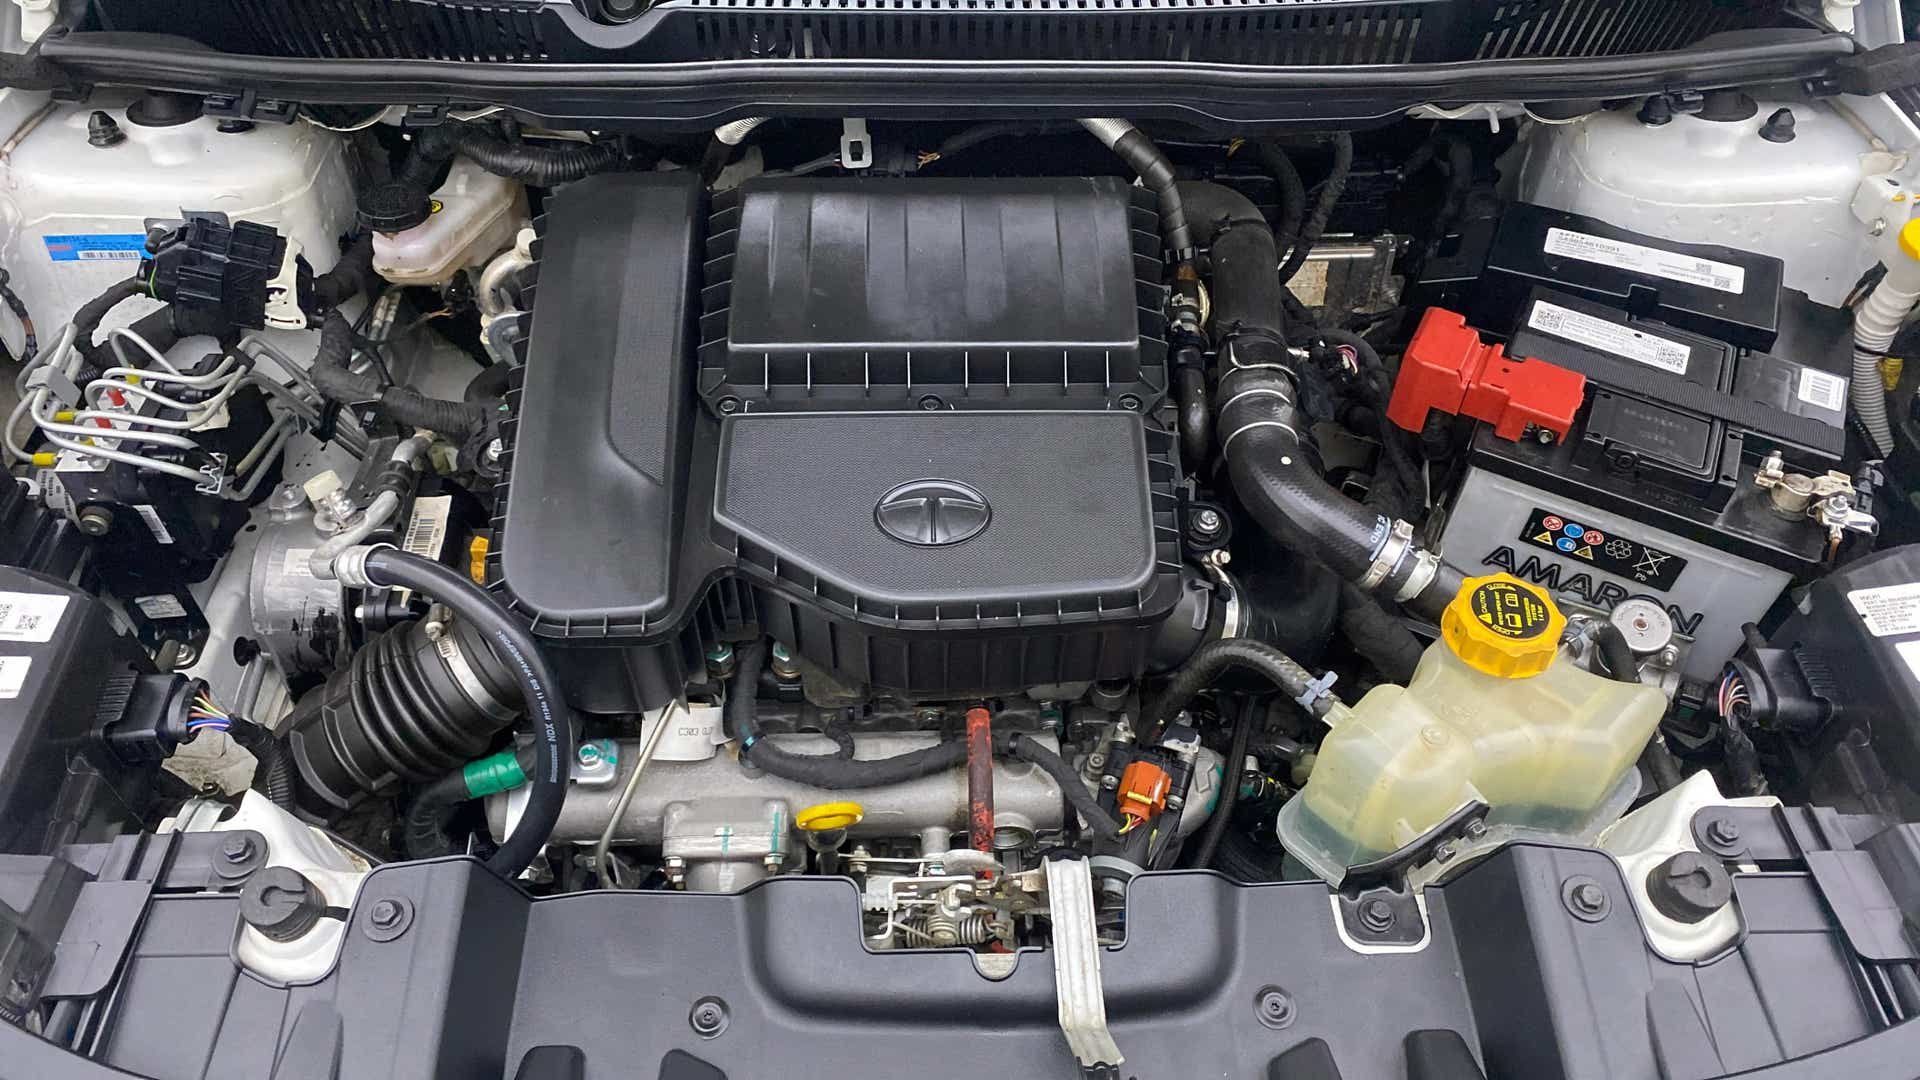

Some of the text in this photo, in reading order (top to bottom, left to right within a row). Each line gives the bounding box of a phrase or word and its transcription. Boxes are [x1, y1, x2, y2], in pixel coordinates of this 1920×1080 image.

[1635, 572, 1647, 582] Pb
[1481, 545, 1704, 635] AMARN
[1479, 590, 1488, 613] CAUTION
[545, 723, 557, 742] NDX
